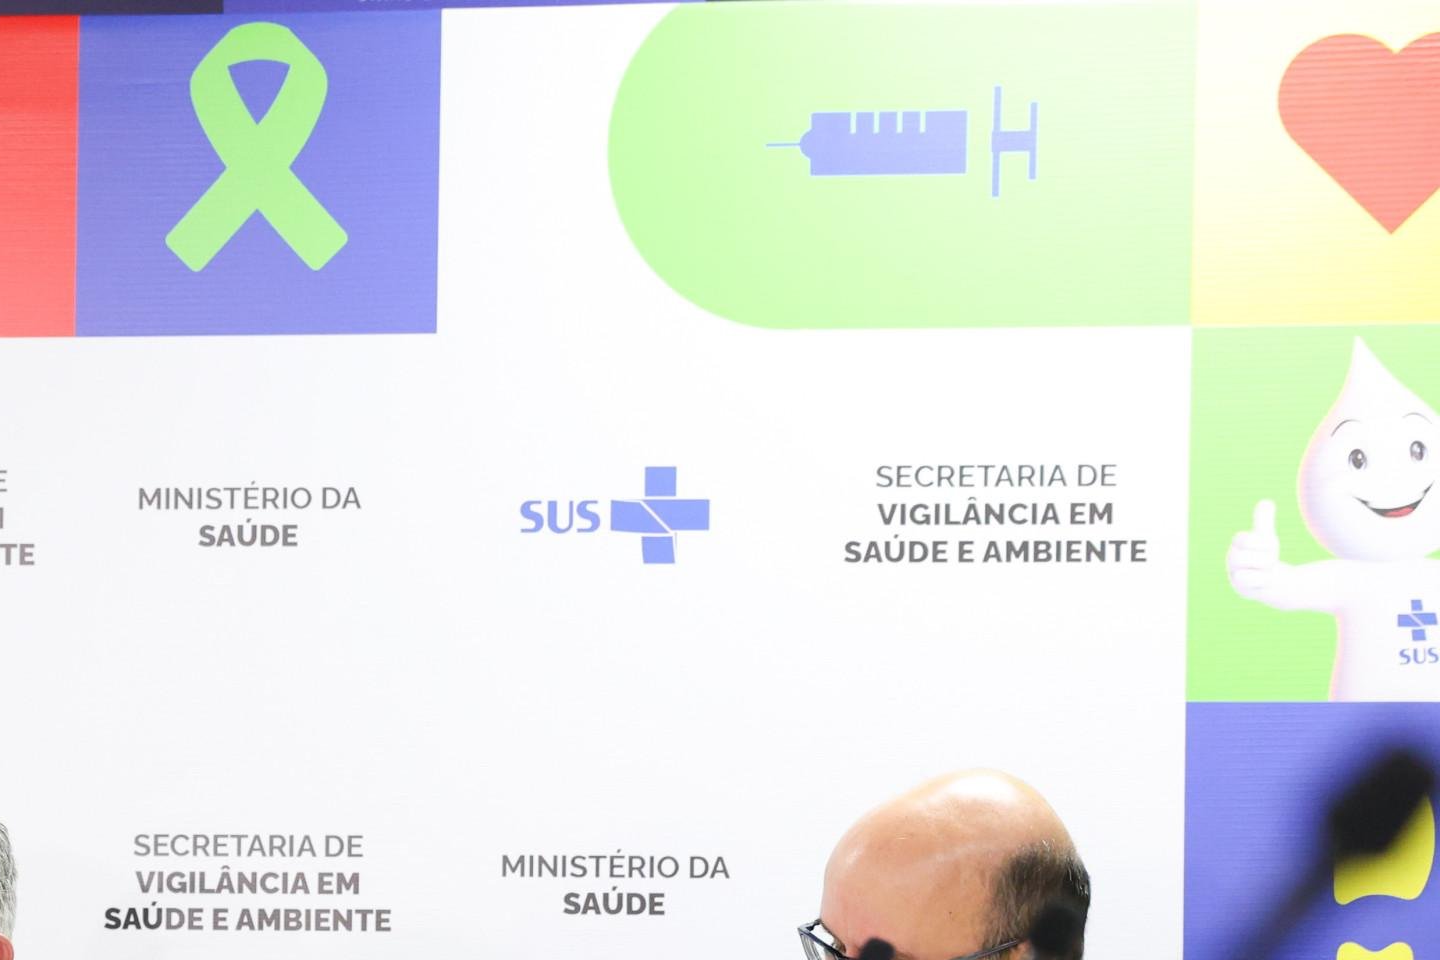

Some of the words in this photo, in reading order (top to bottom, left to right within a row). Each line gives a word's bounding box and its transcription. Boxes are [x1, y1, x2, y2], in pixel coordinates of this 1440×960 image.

[876, 464, 1068, 488] SECRETARIA
[1077, 464, 1117, 487] DE
[138, 480, 313, 511] MINISTÉRIO
[321, 486, 362, 510] DA
[877, 496, 1061, 526] VIGILÂNCIA
[1069, 502, 1113, 525] EM
[198, 517, 299, 548] SAÚDE
[519, 499, 601, 535] SUS
[844, 533, 949, 564] SAÚDE
[957, 540, 975, 563] E
[982, 539, 1147, 563] AMBIENTE
[1398, 647, 1440, 665] SUS
[133, 833, 317, 858] SECRETARIA
[324, 834, 364, 858] DE
[501, 848, 680, 879] MINISTÉRIO
[689, 855, 730, 879] DA
[135, 864, 311, 895] VIGILÂNCIA
[317, 871, 360, 895] EM
[103, 900, 204, 930] SAÚDE
[212, 907, 229, 931] E
[235, 907, 392, 932] AMBIENTE
[563, 885, 666, 916] SAÚDE
